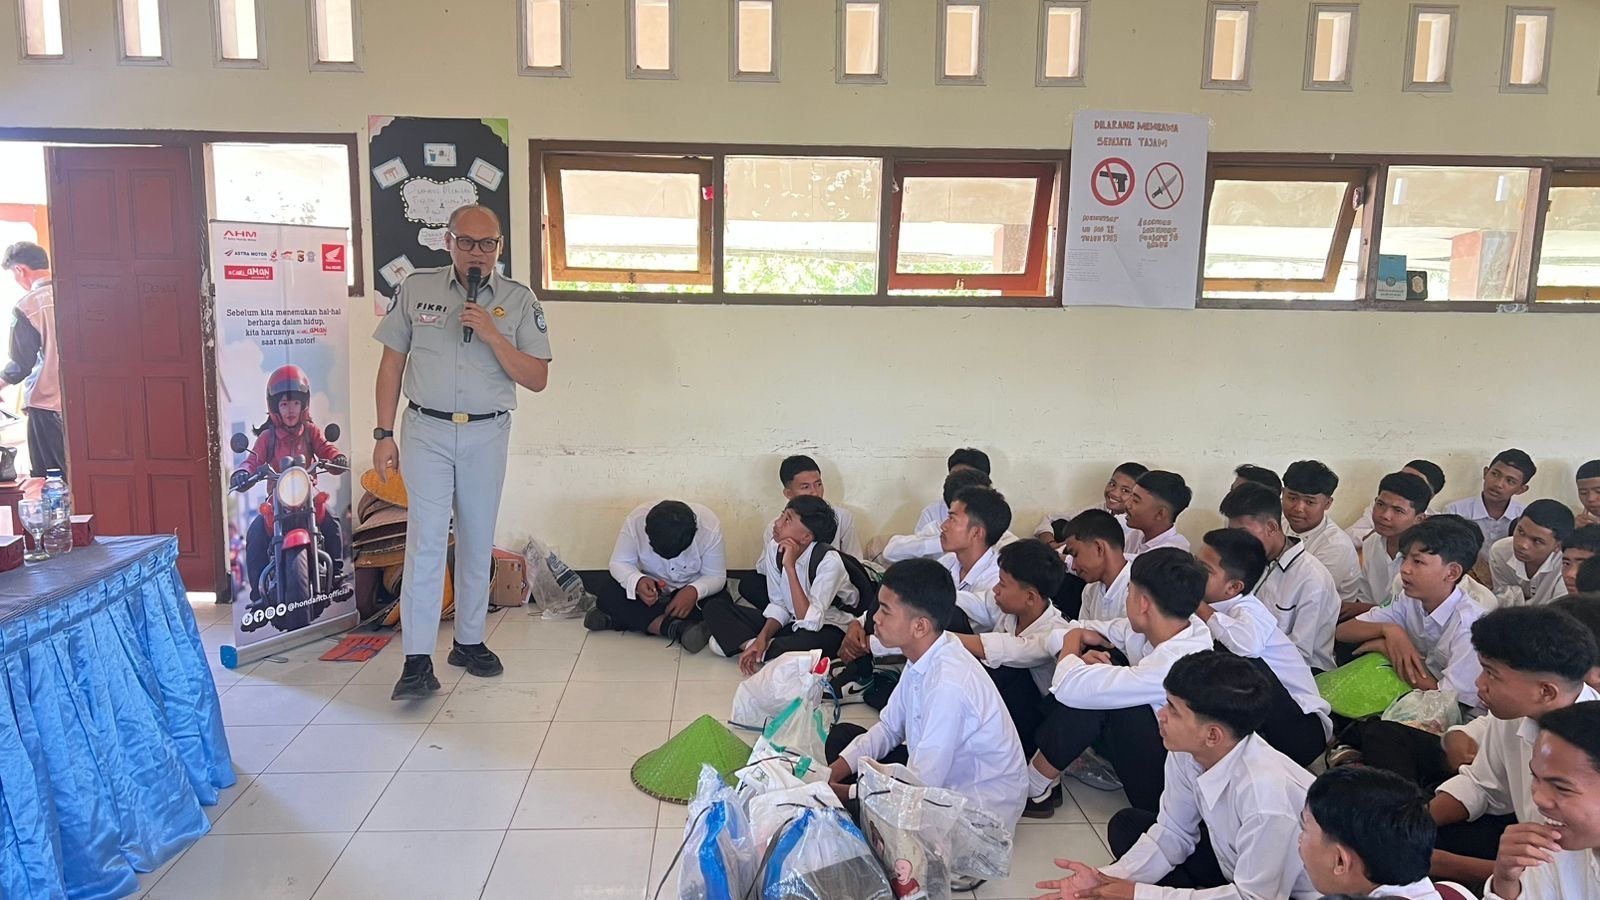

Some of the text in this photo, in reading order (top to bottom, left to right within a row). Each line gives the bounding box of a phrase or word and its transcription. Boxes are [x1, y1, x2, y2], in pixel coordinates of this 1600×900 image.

[1094, 119, 1135, 130] DILARANG
[224, 230, 257, 238] AHM
[416, 302, 448, 313] FIKRI
[226, 308, 259, 317] Sebelum
[260, 308, 274, 316] kita
[275, 308, 317, 316] menemukan
[247, 319, 280, 327] berharga
[282, 318, 302, 326] dalam
[245, 329, 260, 337] kita
[260, 328, 295, 336] harusnya
[261, 336, 316, 346] saat naik motor!
